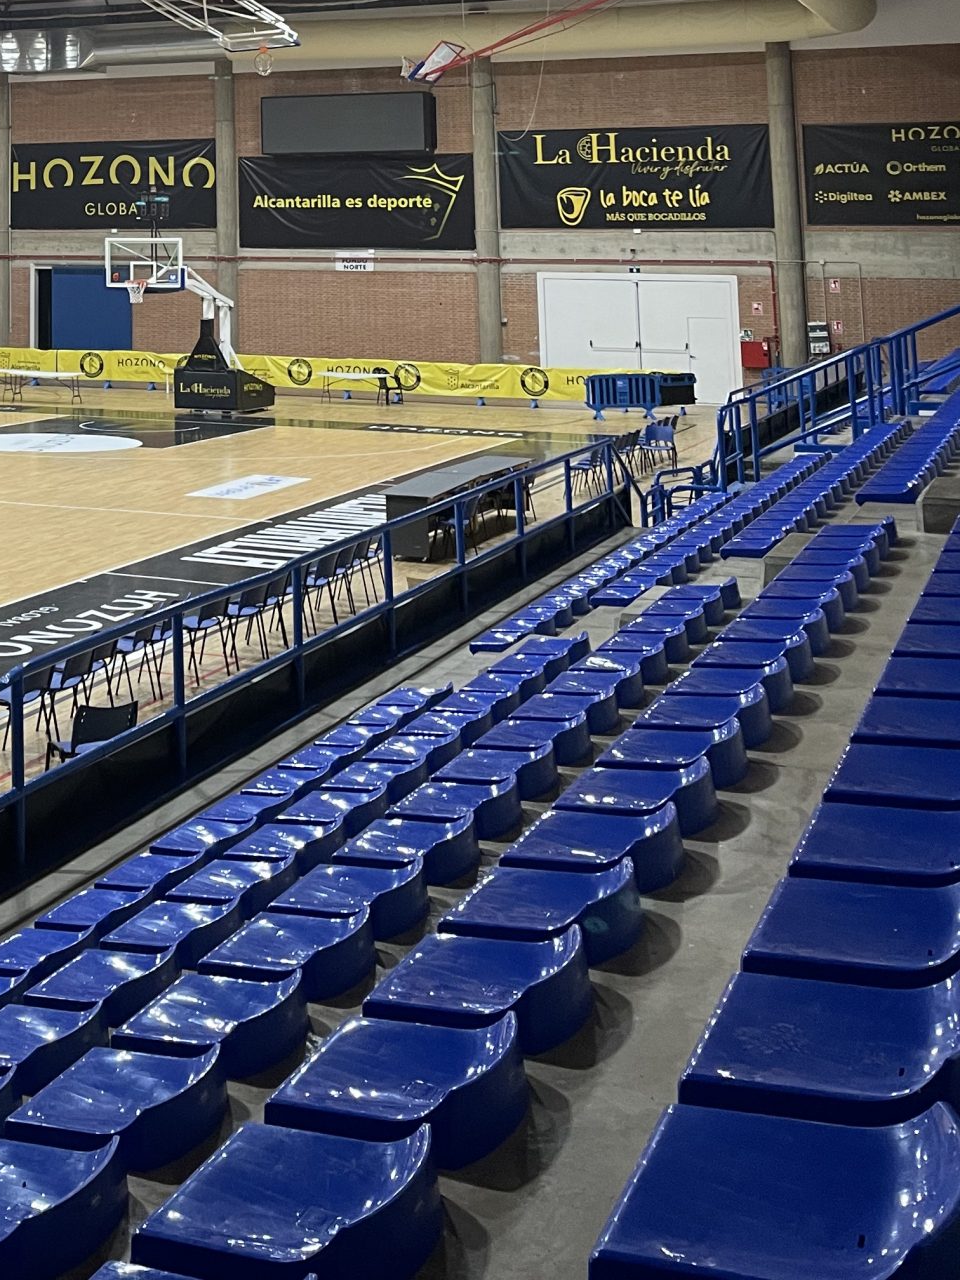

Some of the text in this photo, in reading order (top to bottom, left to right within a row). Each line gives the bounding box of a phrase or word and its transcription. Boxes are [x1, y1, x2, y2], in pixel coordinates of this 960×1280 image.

[532, 132, 731, 165] La Hacienda
[825, 161, 869, 174] ACTÚA
[903, 162, 946, 172] Orthem
[12, 154, 216, 193] HOZONO
[600, 183, 710, 208] la boca te lía
[828, 191, 873, 203] Digiltea
[903, 191, 947, 200] AMBEX
[253, 194, 432, 211] Alcantarilla es deporte
[84, 202, 138, 216] GLOBA
[606, 211, 706, 221] MÁS QUE BOCADILLOS
[117, 358, 166, 368] HOZONO
[326, 365, 371, 374] HOZON
[179, 382, 231, 394] La Hacienda
